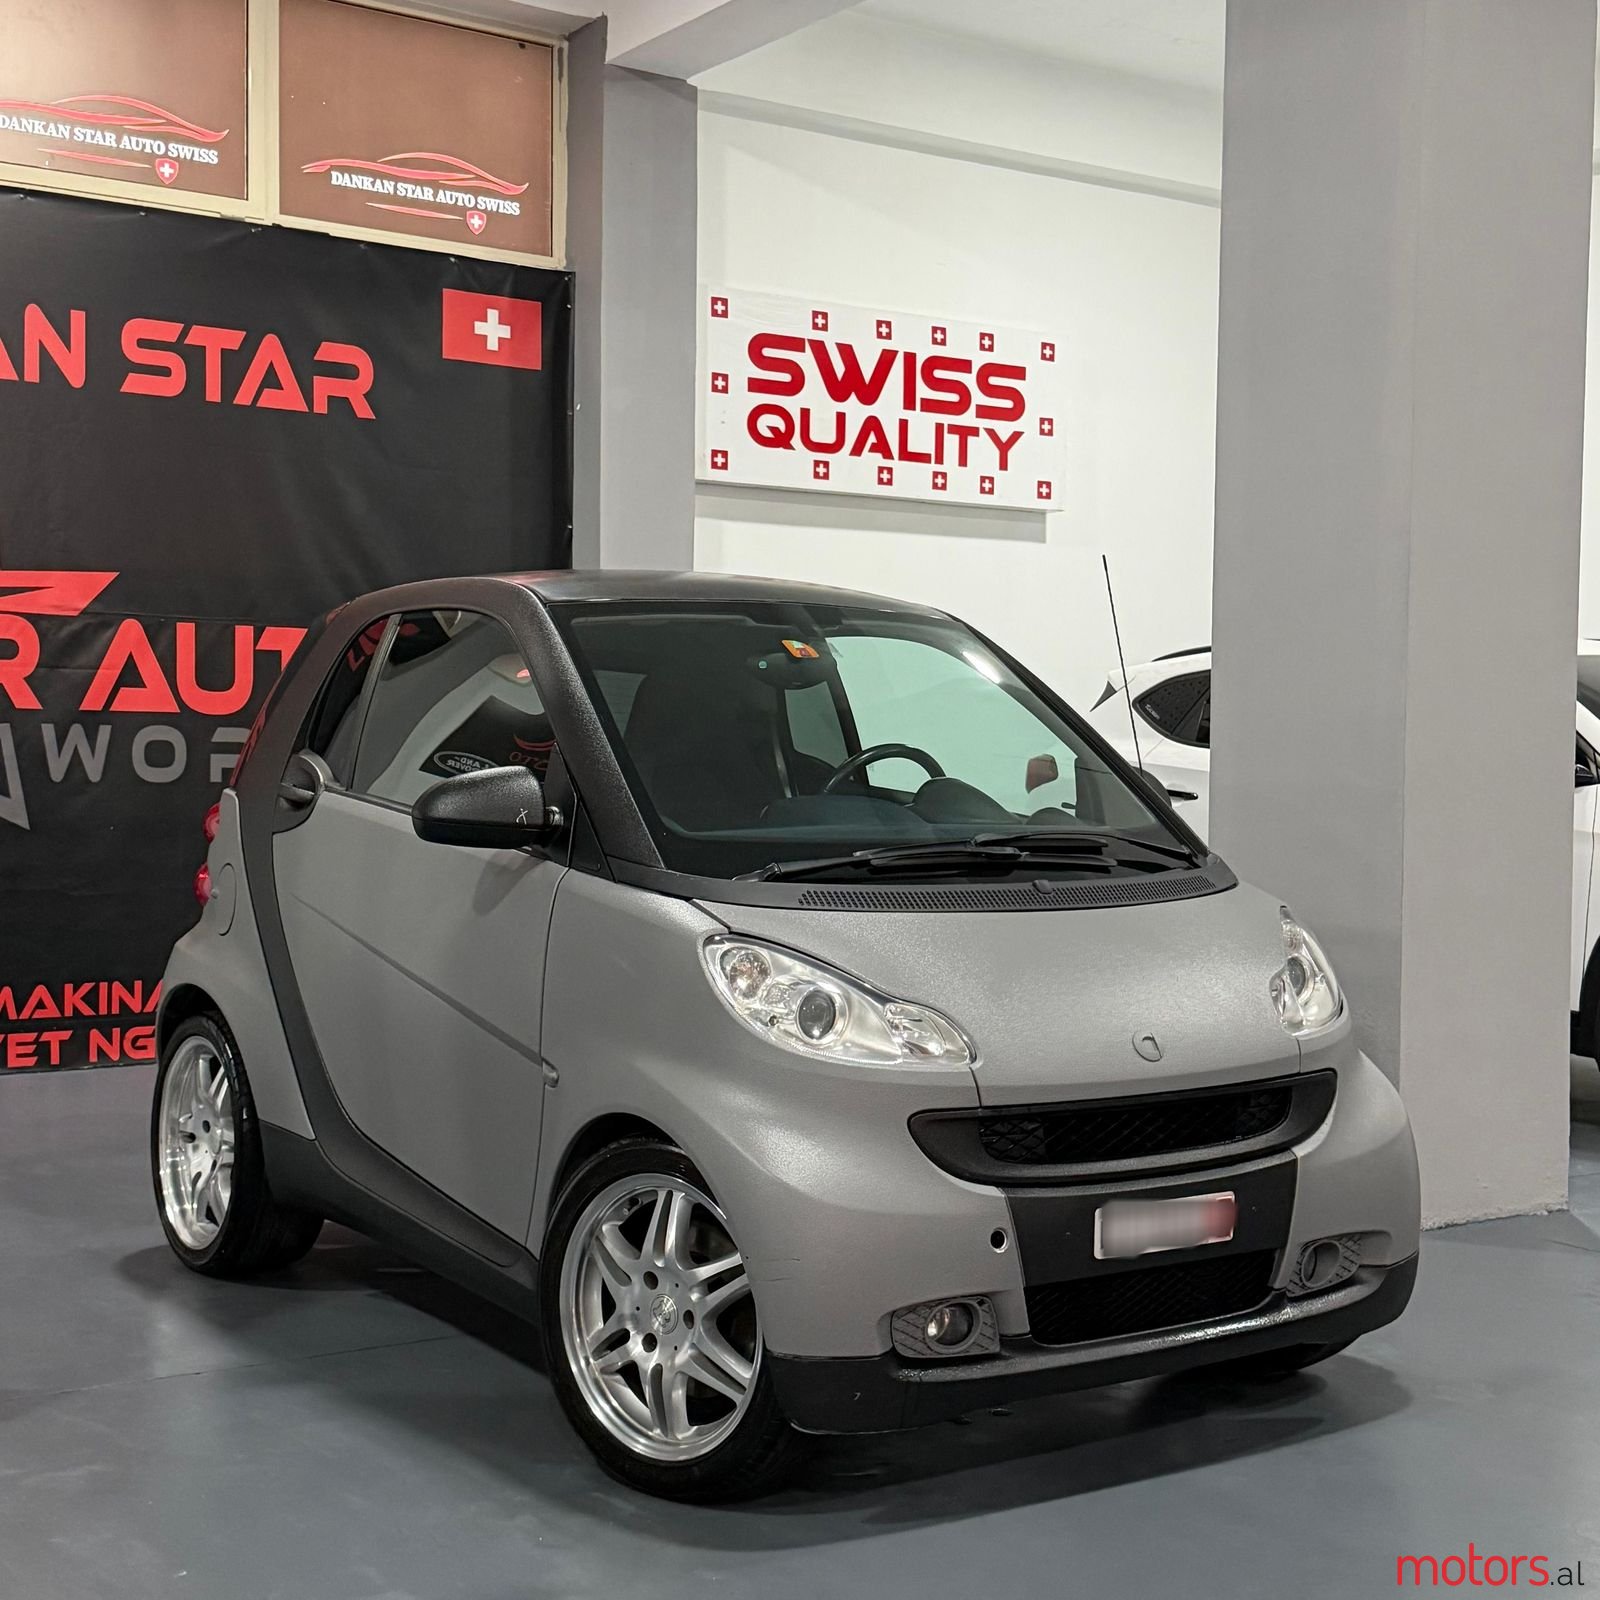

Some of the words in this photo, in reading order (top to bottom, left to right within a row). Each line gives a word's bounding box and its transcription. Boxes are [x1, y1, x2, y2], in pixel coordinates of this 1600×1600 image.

[0, 114, 70, 140] DANKAN
[73, 126, 117, 148] STAR
[119, 135, 166, 155] AUTO
[167, 142, 219, 165] SWISS
[331, 170, 394, 194] DANKAN
[397, 183, 434, 202] STAR
[436, 190, 476, 208] AUTO
[477, 196, 520, 216] SWISS
[0, 304, 86, 388] N
[120, 318, 374, 419] STAR
[747, 333, 1027, 422] SWISS
[747, 403, 1025, 472] QUALITY
[0, 1030, 73, 1068] ET
